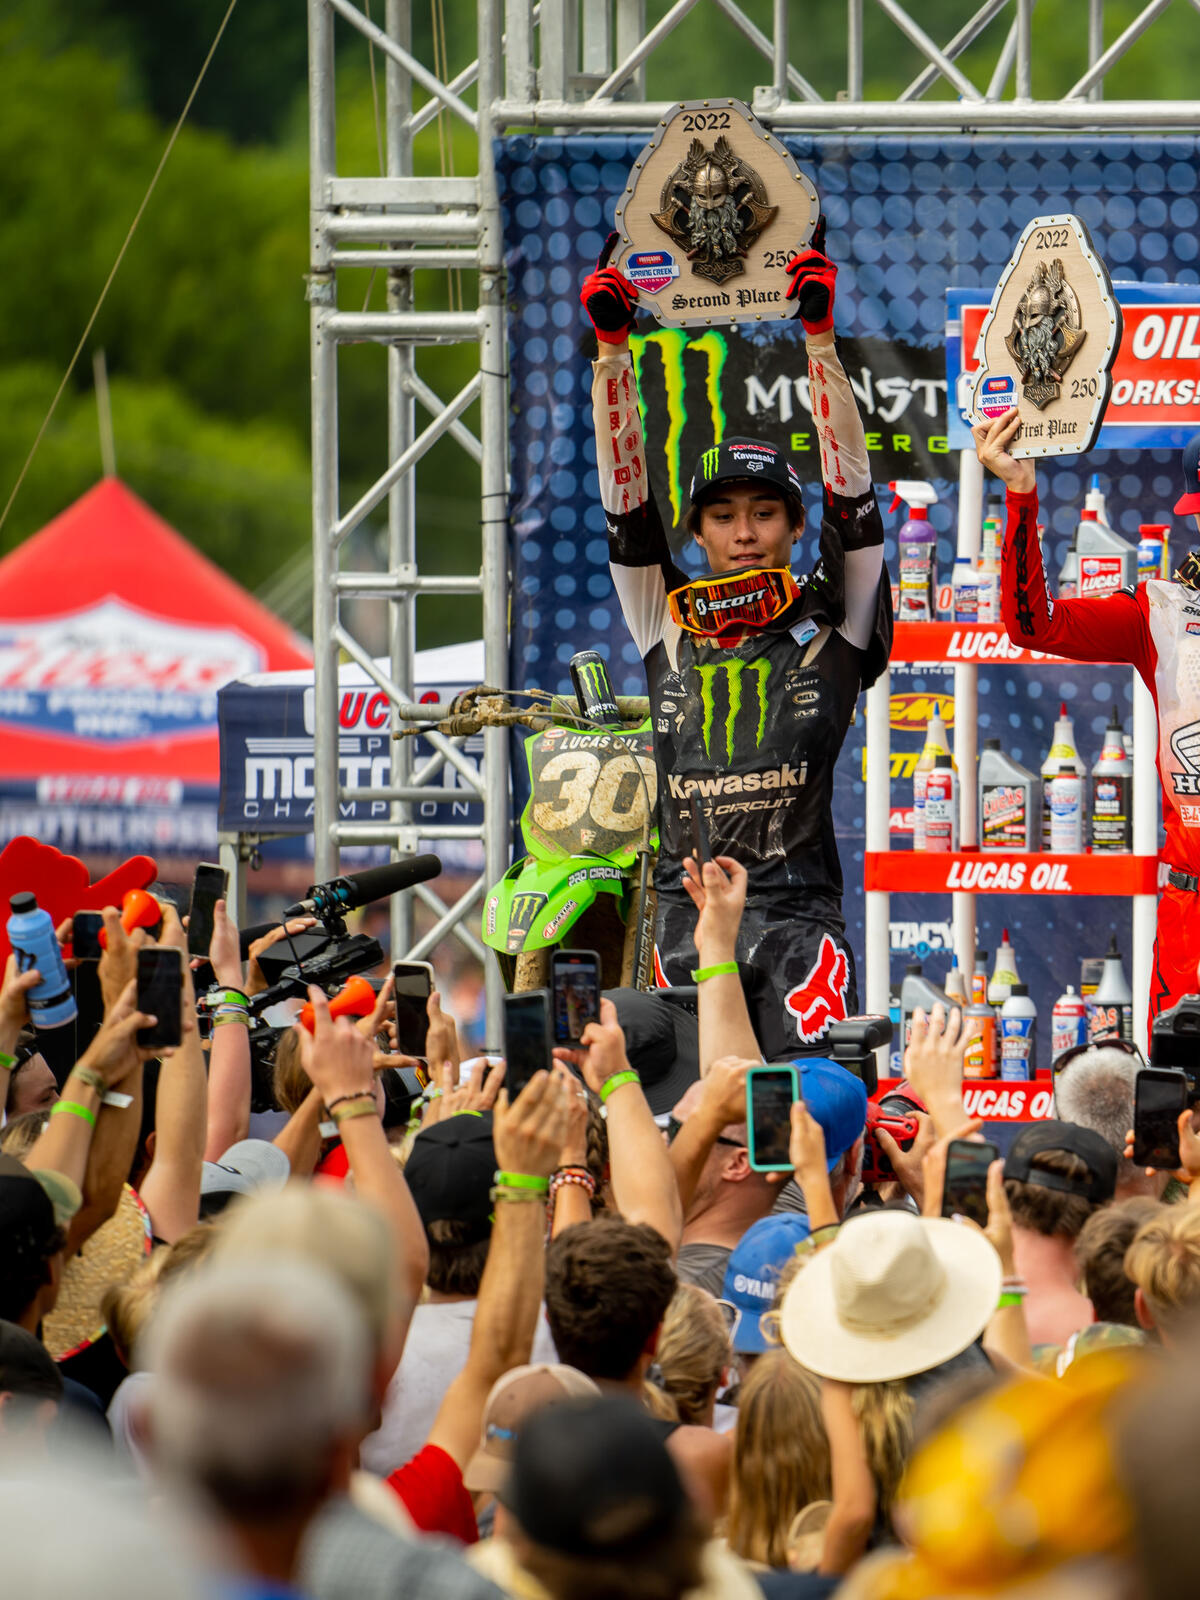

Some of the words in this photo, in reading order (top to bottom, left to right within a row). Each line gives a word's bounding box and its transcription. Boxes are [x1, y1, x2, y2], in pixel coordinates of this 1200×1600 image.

[682, 112, 731, 132] 2022
[1036, 229, 1069, 250] 2022
[630, 268, 652, 278] SPRING
[652, 266, 673, 277] CREEK
[672, 292, 730, 310] Second
[736, 288, 781, 308] Place
[1070, 377, 1097, 400] 250
[1047, 419, 1078, 440] Place
[733, 452, 775, 464] Kawasaki
[1081, 572, 1121, 591] LUCAS
[707, 588, 767, 611] SCOTT
[946, 631, 1023, 659] LUCAS
[560, 736, 611, 750] LUCAS
[613, 737, 639, 752] OIL
[668, 761, 808, 800] Kawasaki
[533, 751, 658, 832] 30
[715, 797, 797, 816] CIRCUIT
[984, 788, 1025, 817] LUCAS
[568, 868, 588, 888] PRO
[946, 861, 1027, 890] LUCAS
[963, 1090, 1024, 1117] UCAS
[746, 1282, 776, 1300] YAM
